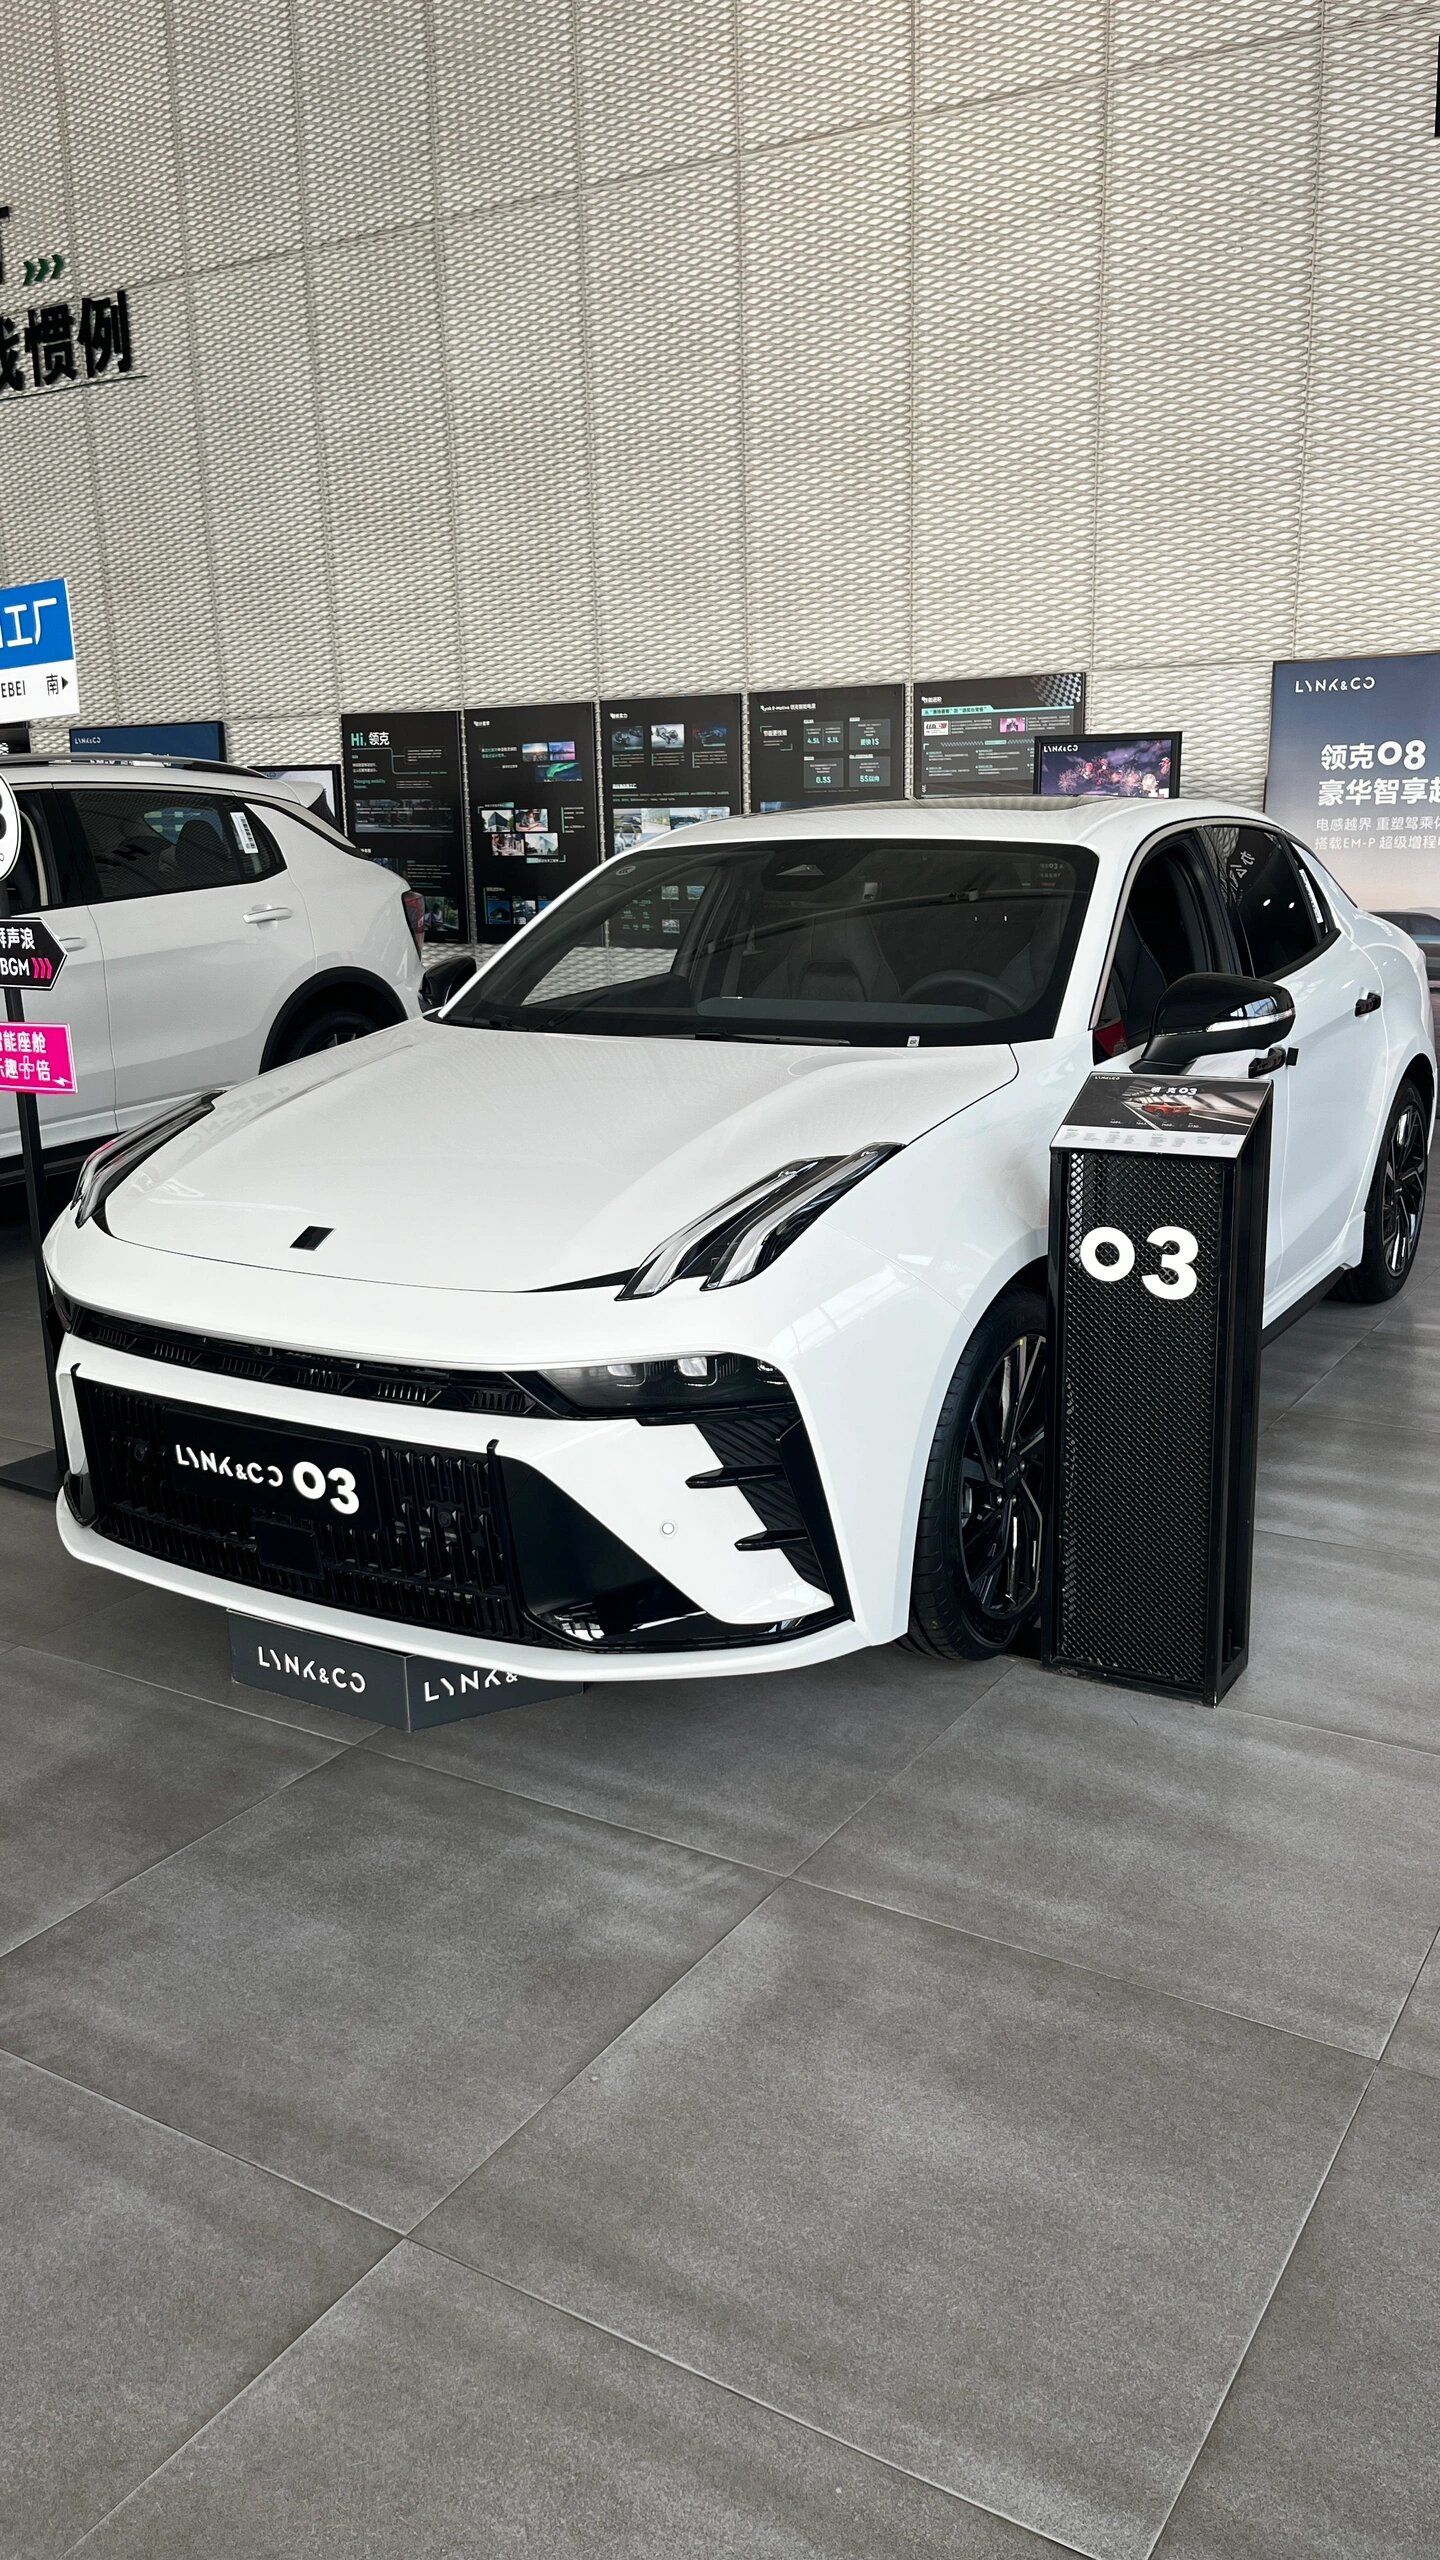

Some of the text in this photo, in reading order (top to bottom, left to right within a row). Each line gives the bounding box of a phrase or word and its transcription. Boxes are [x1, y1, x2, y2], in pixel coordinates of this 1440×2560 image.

[0, 598, 57, 649] 工厂
[46, 673, 59, 695] 南
[1295, 675, 1375, 693] LYNK&CO
[351, 732, 390, 747] Hi. 领克
[1043, 744, 1079, 753] LYNK&CO
[1316, 817, 1372, 831] 电感越界
[1379, 835, 1440, 849] 超级增程
[0, 1031, 47, 1054] 能座舱
[1080, 1225, 1199, 1301] 03
[174, 1443, 360, 1516] LYNK&CO 03
[256, 1645, 367, 1694] LYNK&CO
